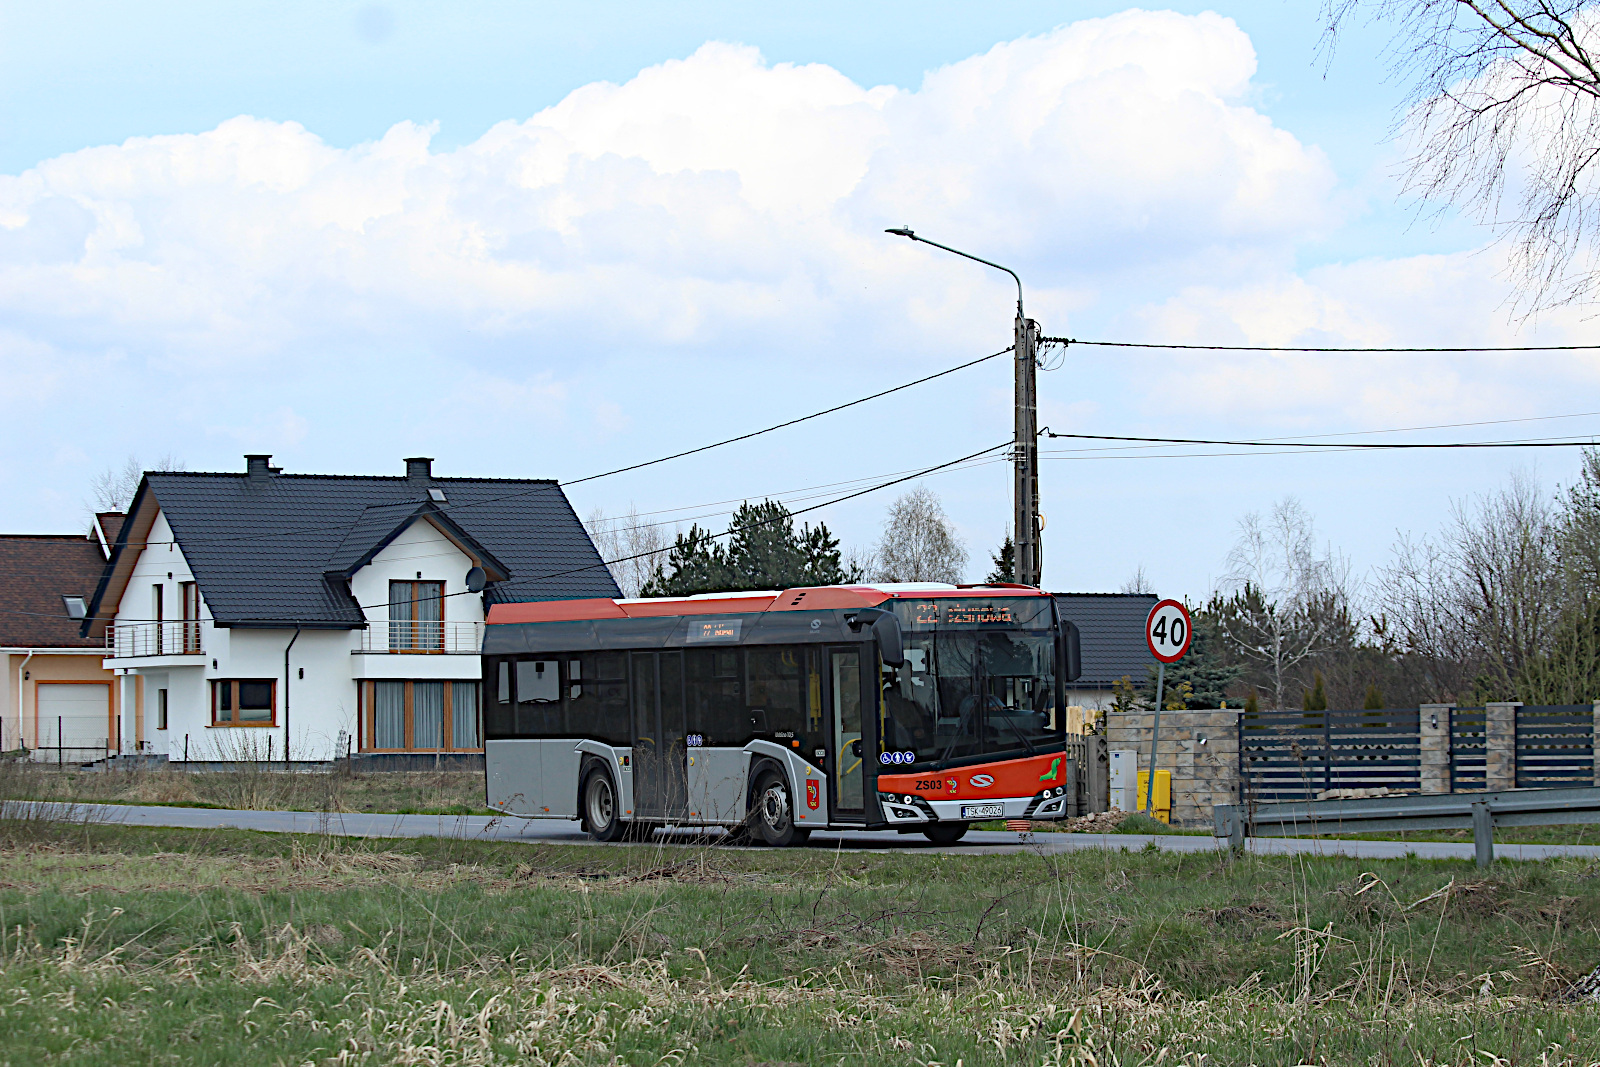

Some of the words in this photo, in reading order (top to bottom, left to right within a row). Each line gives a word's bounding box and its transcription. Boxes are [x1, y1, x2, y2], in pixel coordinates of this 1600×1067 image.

[916, 604, 938, 623] 22
[1152, 616, 1185, 647] 40
[915, 780, 942, 790] ZS03
[966, 807, 979, 816] TSK
[981, 806, 1002, 815] 49026
